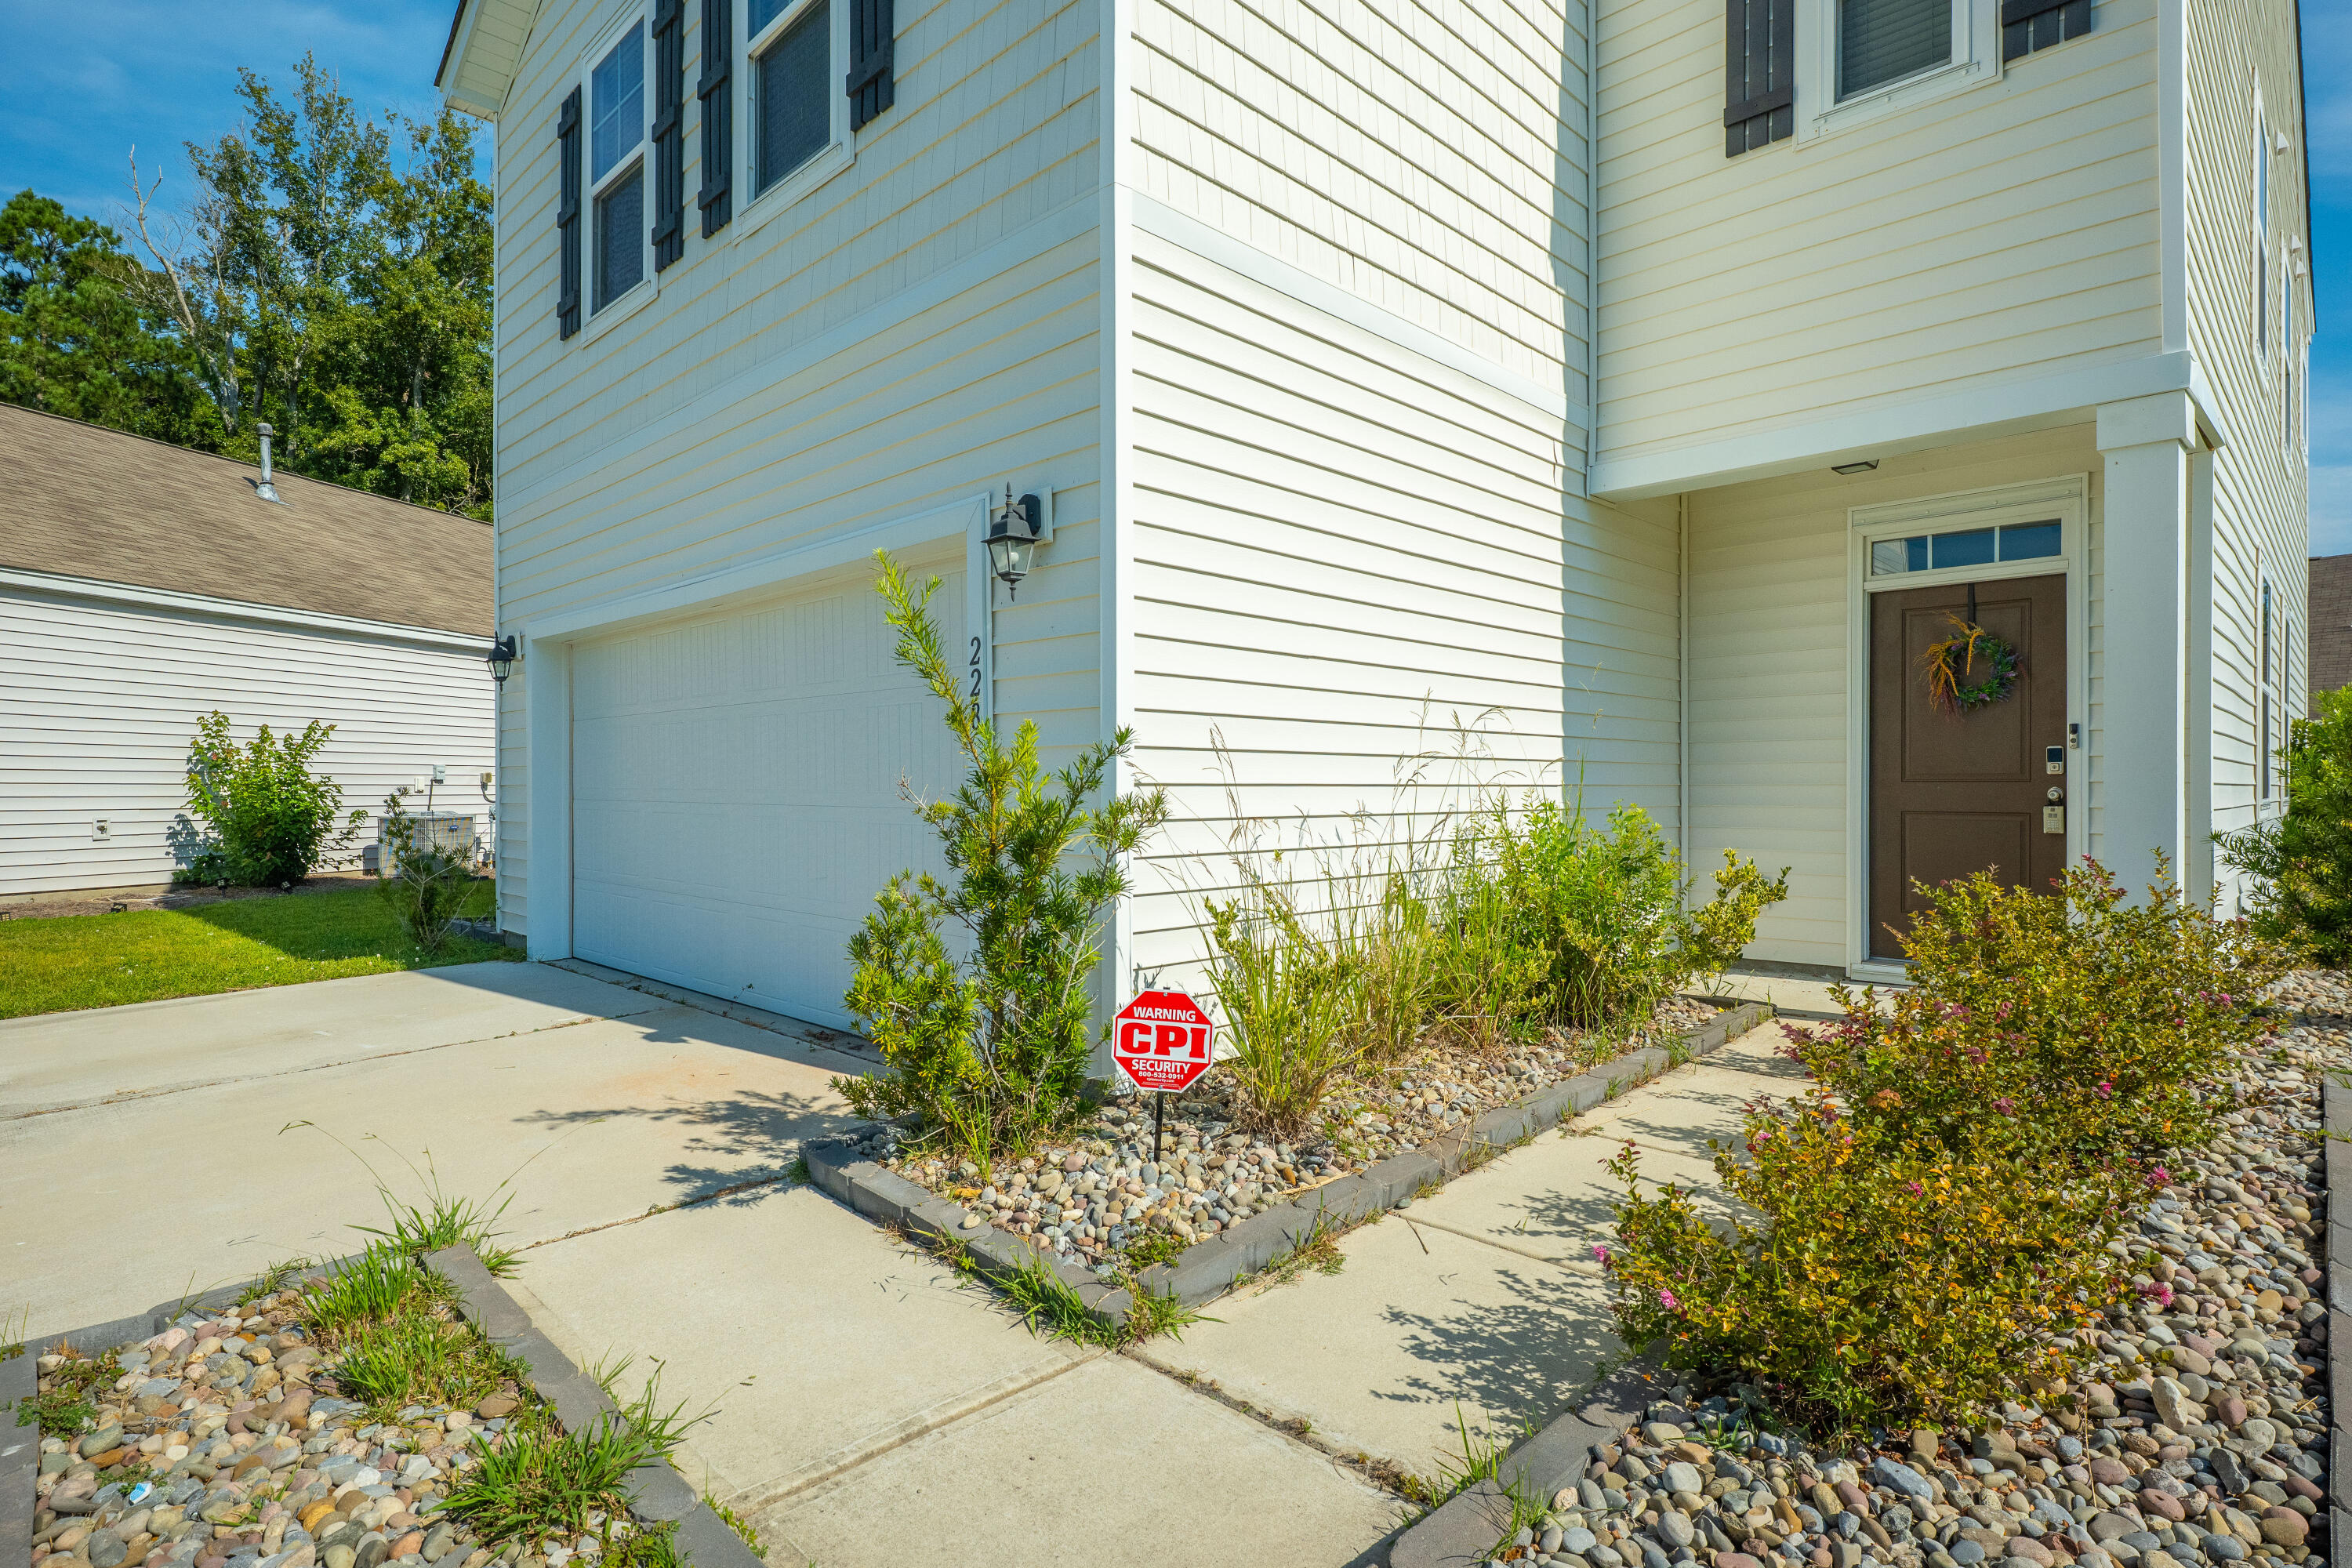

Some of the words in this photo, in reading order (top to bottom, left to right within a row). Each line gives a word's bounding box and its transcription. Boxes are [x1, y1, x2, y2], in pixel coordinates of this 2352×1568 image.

[1133, 1006, 1196, 1022] WARNING
[1120, 1022, 1207, 1059] CPI
[1131, 1058, 1192, 1074] SECURITY
[1138, 1071, 1184, 1080] 800-532-0911
